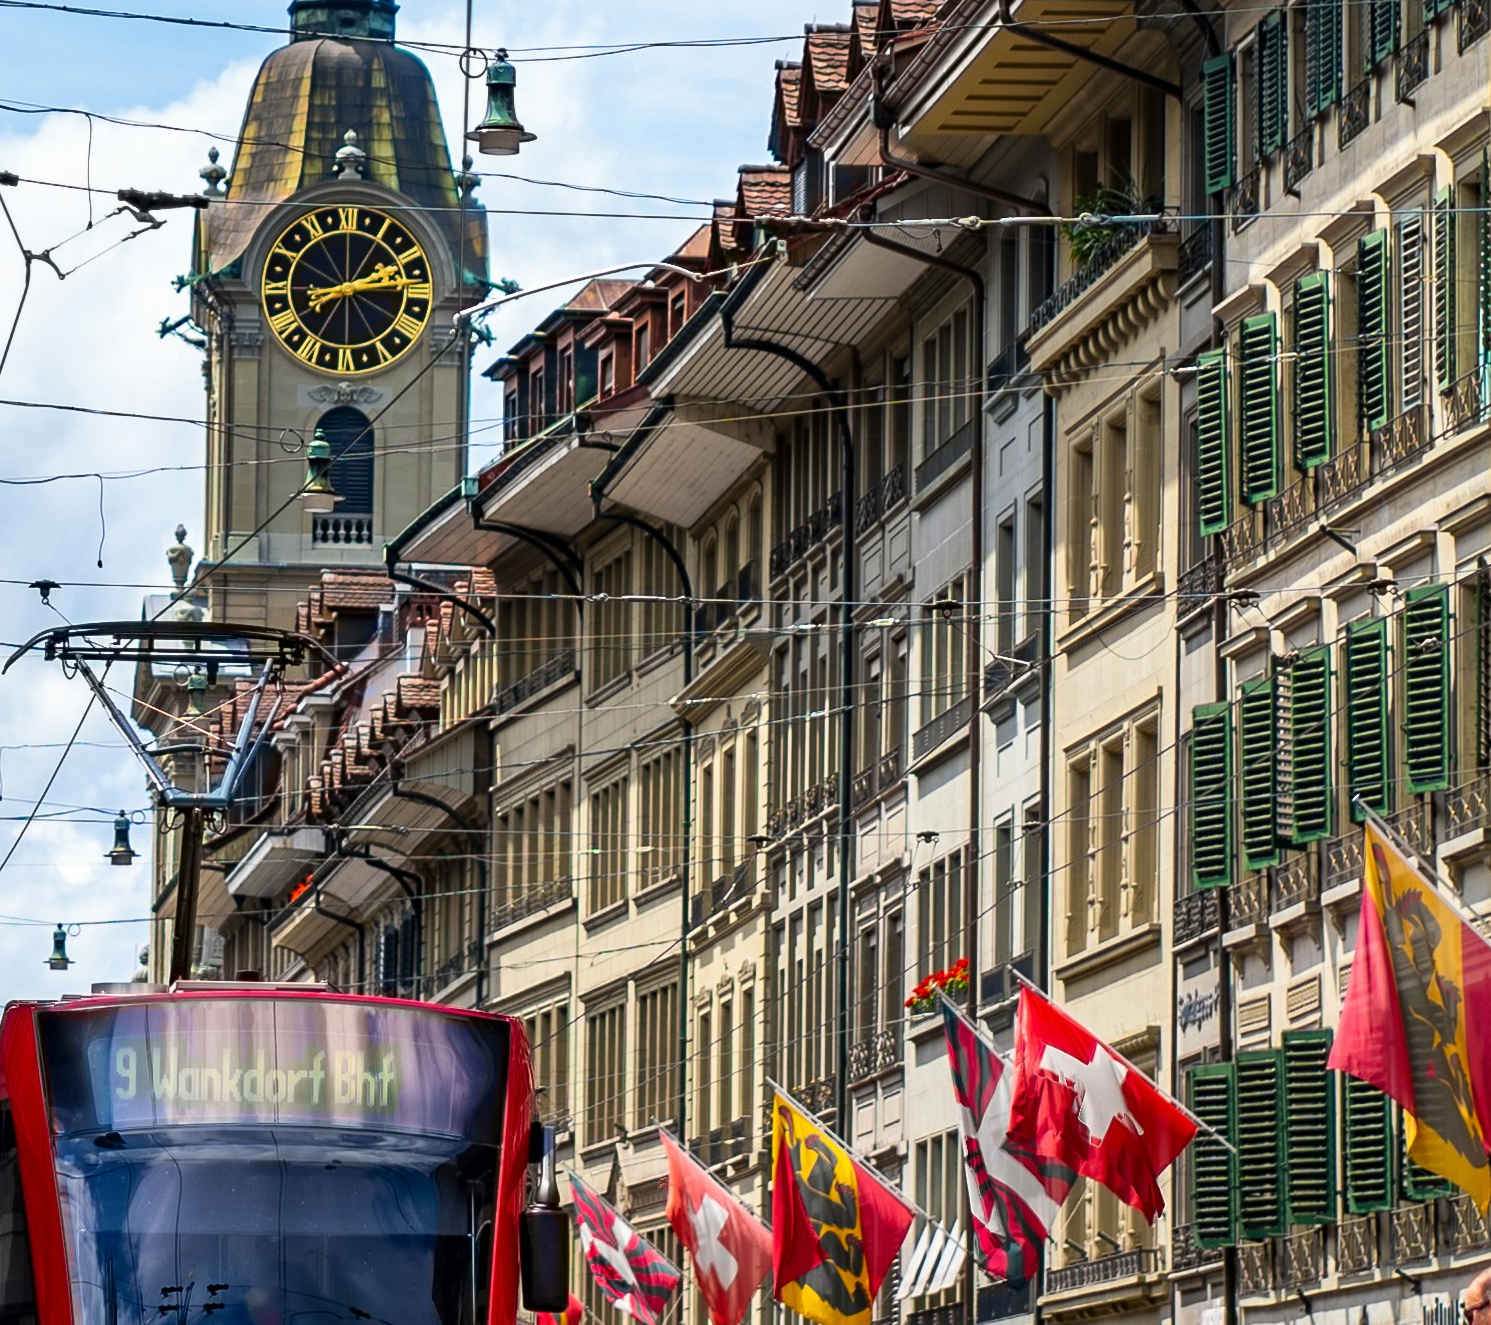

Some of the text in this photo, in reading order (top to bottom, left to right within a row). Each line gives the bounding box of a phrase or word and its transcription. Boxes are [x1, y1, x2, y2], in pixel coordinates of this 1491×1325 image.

[338, 208, 359, 230] XII
[116, 1047, 395, 1107] 9 Wankdorf Bhf
